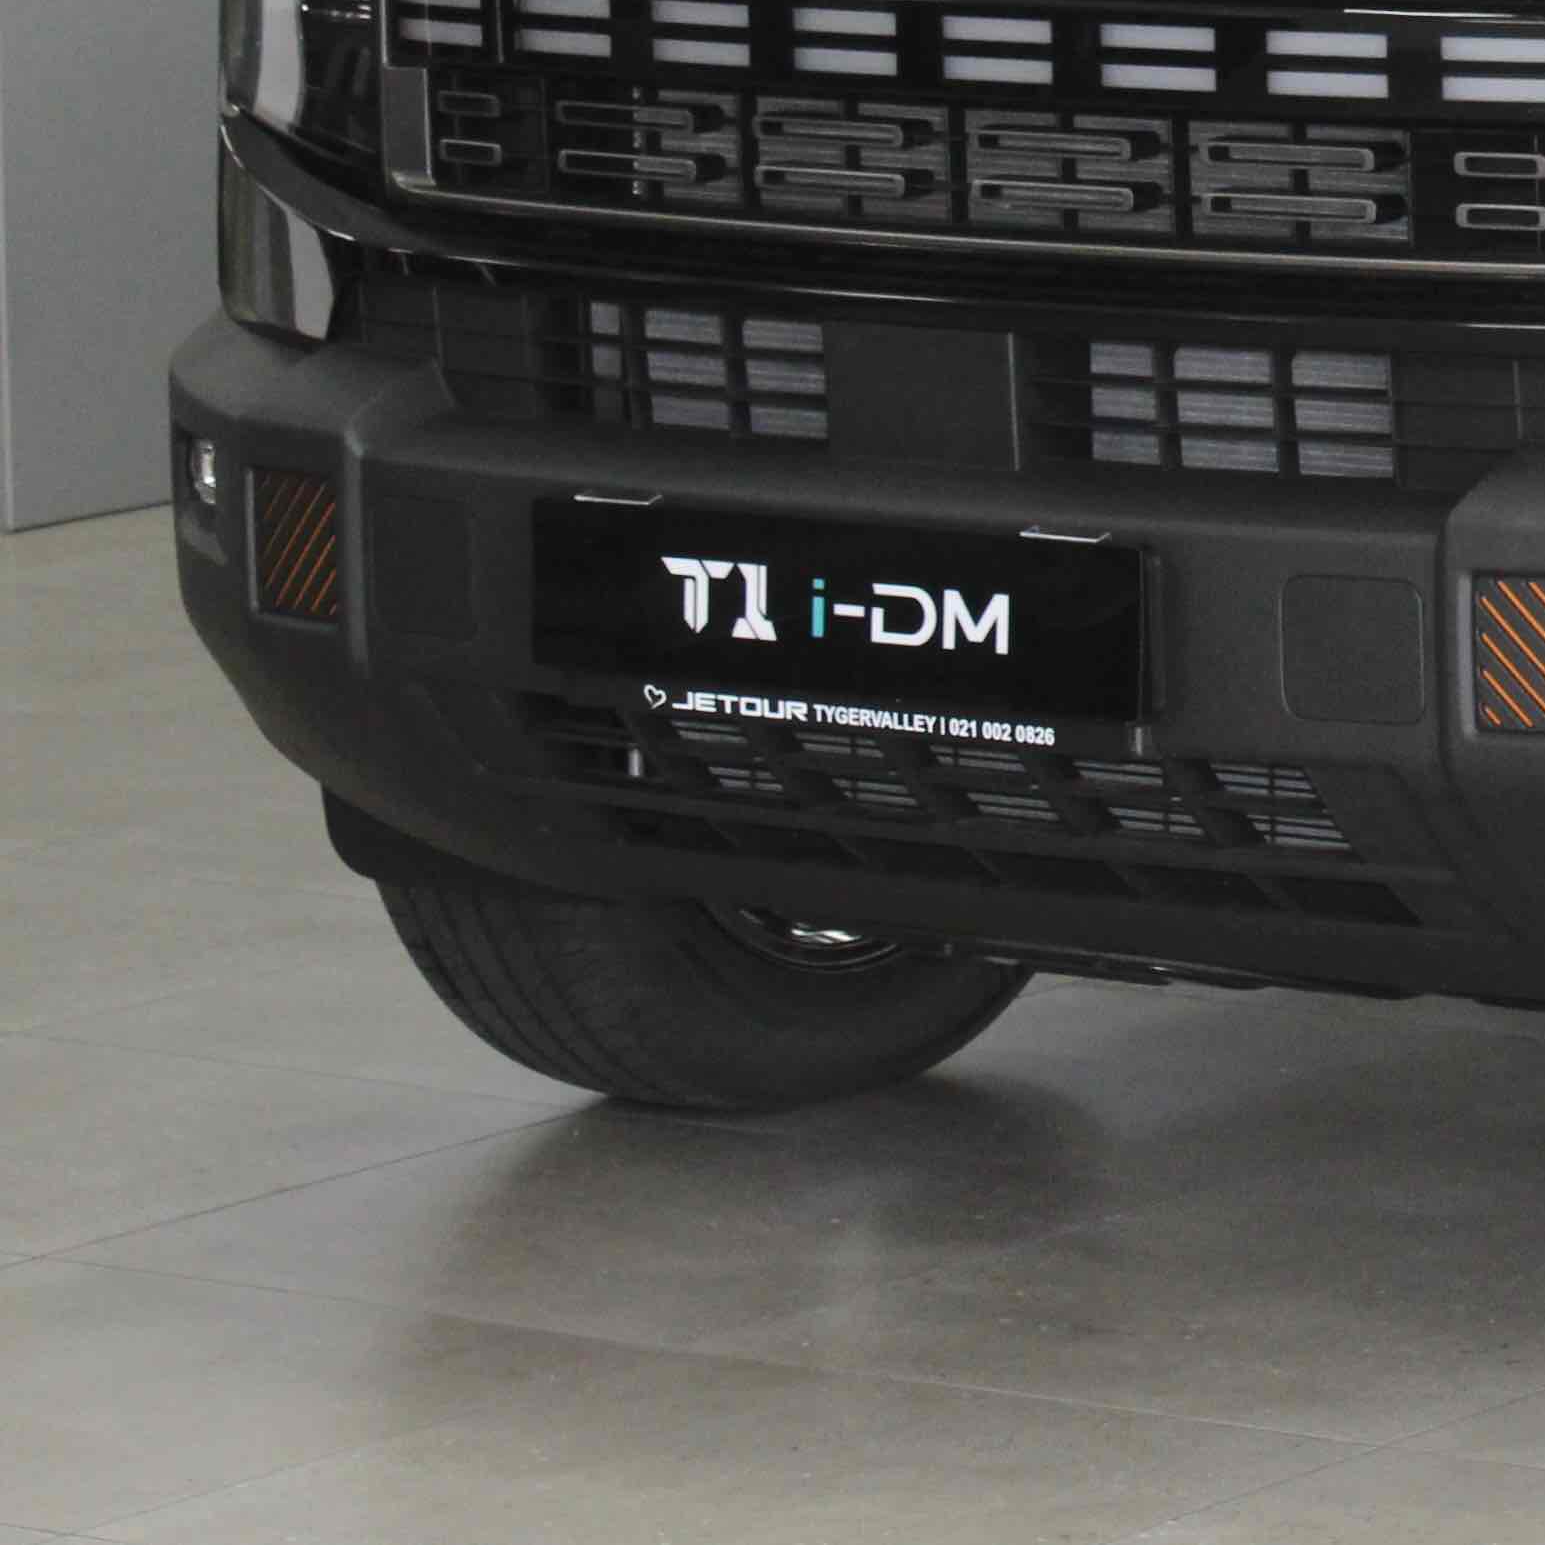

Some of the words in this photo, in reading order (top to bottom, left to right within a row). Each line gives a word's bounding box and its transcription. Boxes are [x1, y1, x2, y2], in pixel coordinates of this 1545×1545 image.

[660, 556, 778, 642] T1
[811, 578, 1010, 656] i-DM
[671, 691, 809, 722] JETOUR
[812, 703, 937, 734] TYGERVALLEY
[948, 717, 978, 739] 021
[981, 720, 1013, 742] 002
[1014, 724, 1056, 746] 0826
